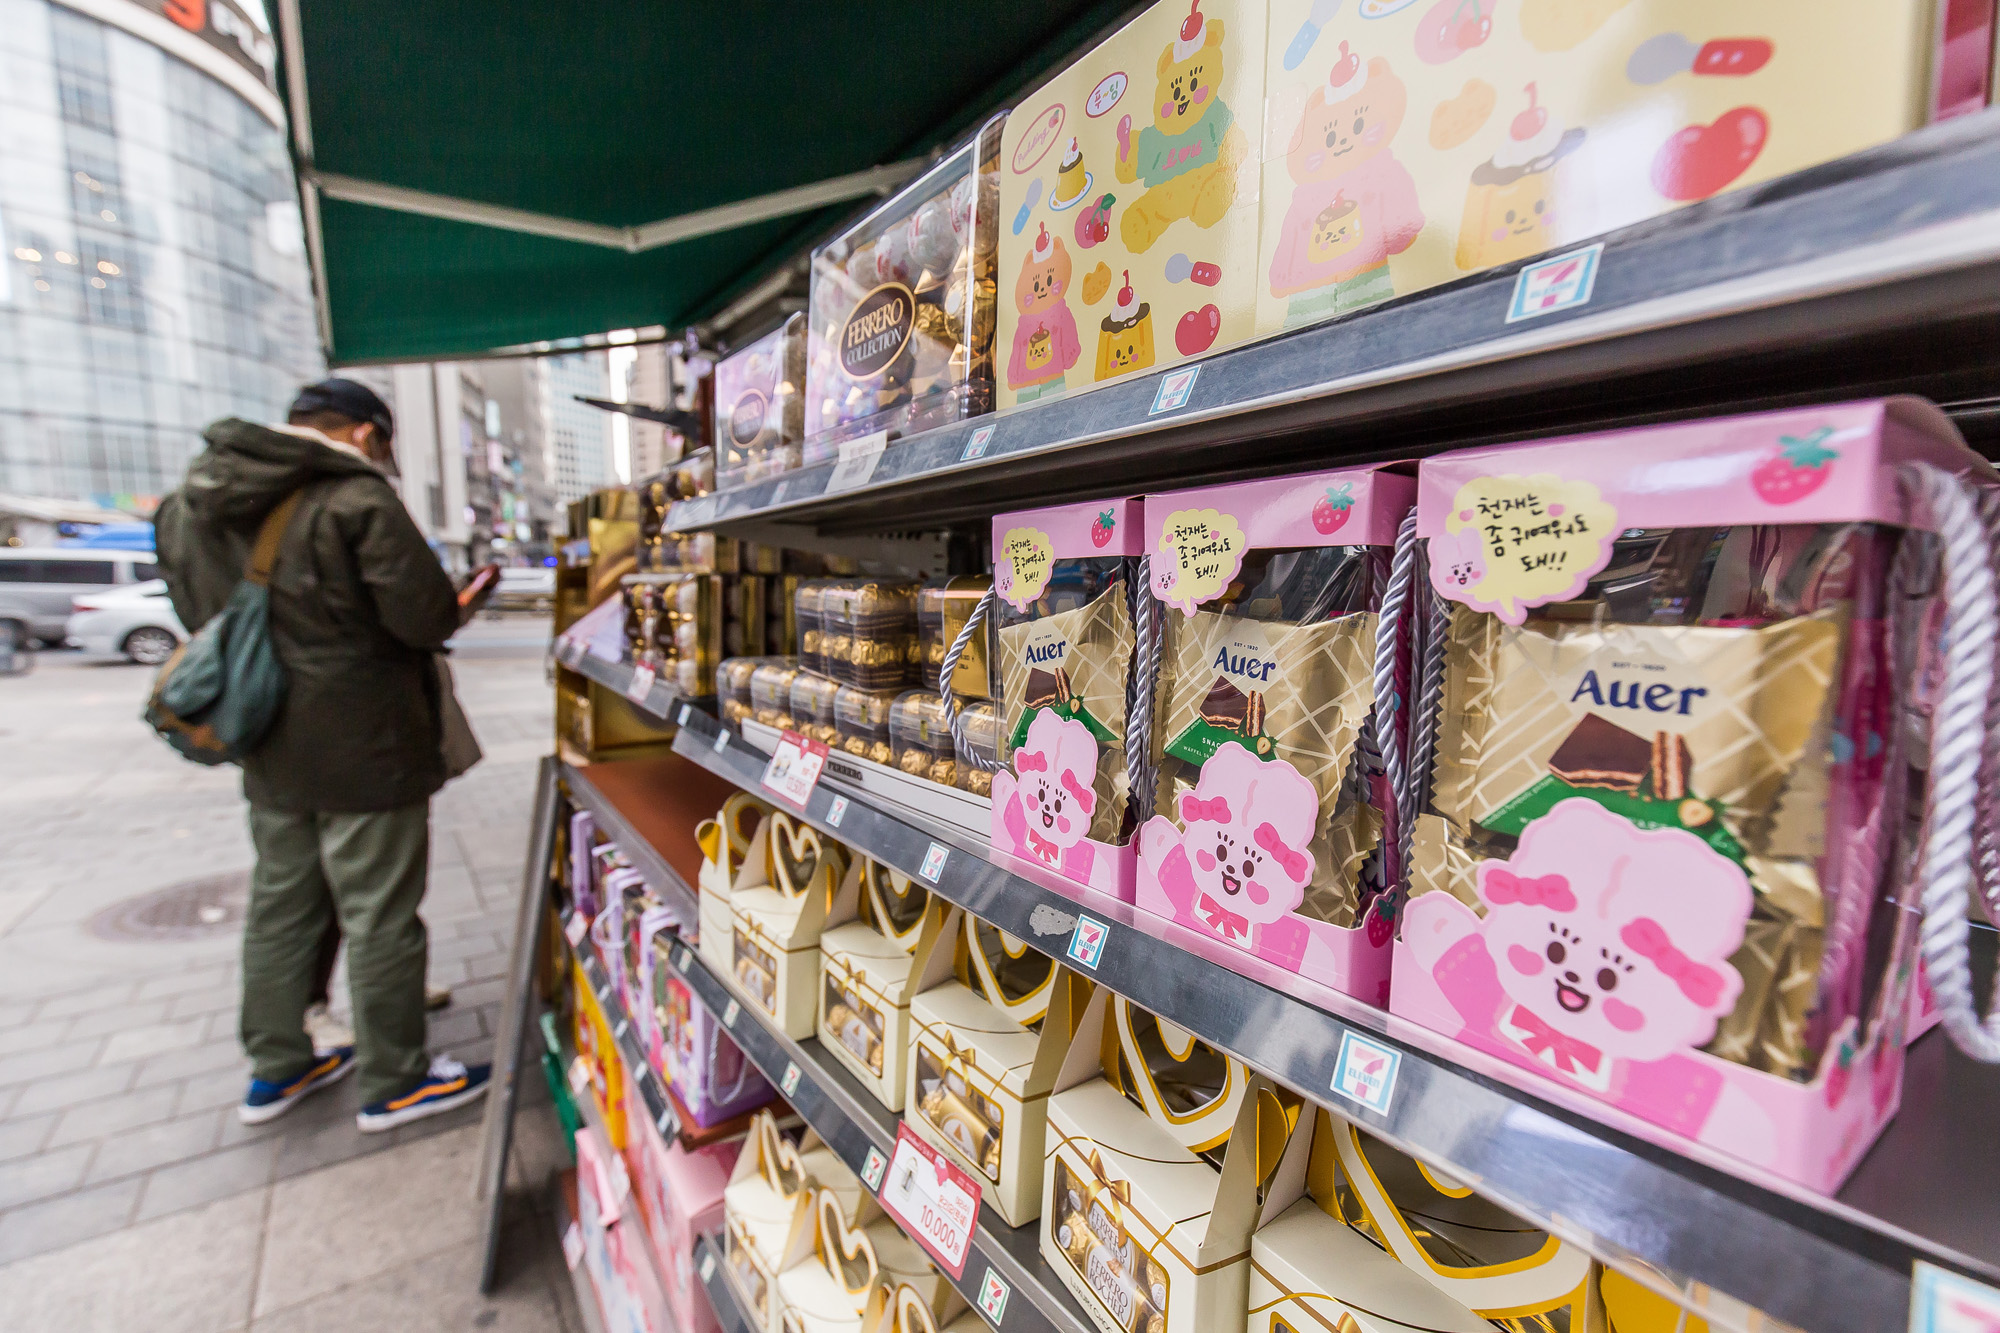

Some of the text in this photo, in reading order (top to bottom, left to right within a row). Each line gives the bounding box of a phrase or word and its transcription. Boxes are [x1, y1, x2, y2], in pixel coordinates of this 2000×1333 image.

[1537, 258, 1580, 309] 7
[847, 297, 904, 348] FERRERO
[846, 325, 902, 366] COLLECTION
[1165, 374, 1190, 408] 7
[1477, 493, 1543, 520] 천재는
[1011, 539, 1032, 553] 천재는
[1174, 522, 1209, 542] 천재는
[1484, 525, 1505, 557] 좀
[1013, 556, 1021, 575] 좀
[1178, 545, 1188, 569] 좀
[1194, 563, 1219, 579] 돼!!
[1520, 551, 1567, 572] 돼!!
[1025, 640, 1067, 665] Auer
[1212, 646, 1277, 682] Auer
[1570, 669, 1709, 716] Auer
[1202, 737, 1221, 748] SNAC
[827, 760, 863, 781] FERRERO
[1078, 939, 1096, 953] ELEVEN
[1080, 924, 1101, 960] 7
[1348, 1067, 1380, 1089] ELEVEN
[1354, 1046, 1385, 1099] 7
[868, 1156, 881, 1182] 7
[1091, 1207, 1128, 1259] FERREO
[1089, 1267, 1127, 1324] ROCHER
[1091, 1254, 1128, 1308] FERRERO
[988, 1280, 1003, 1312] 7
